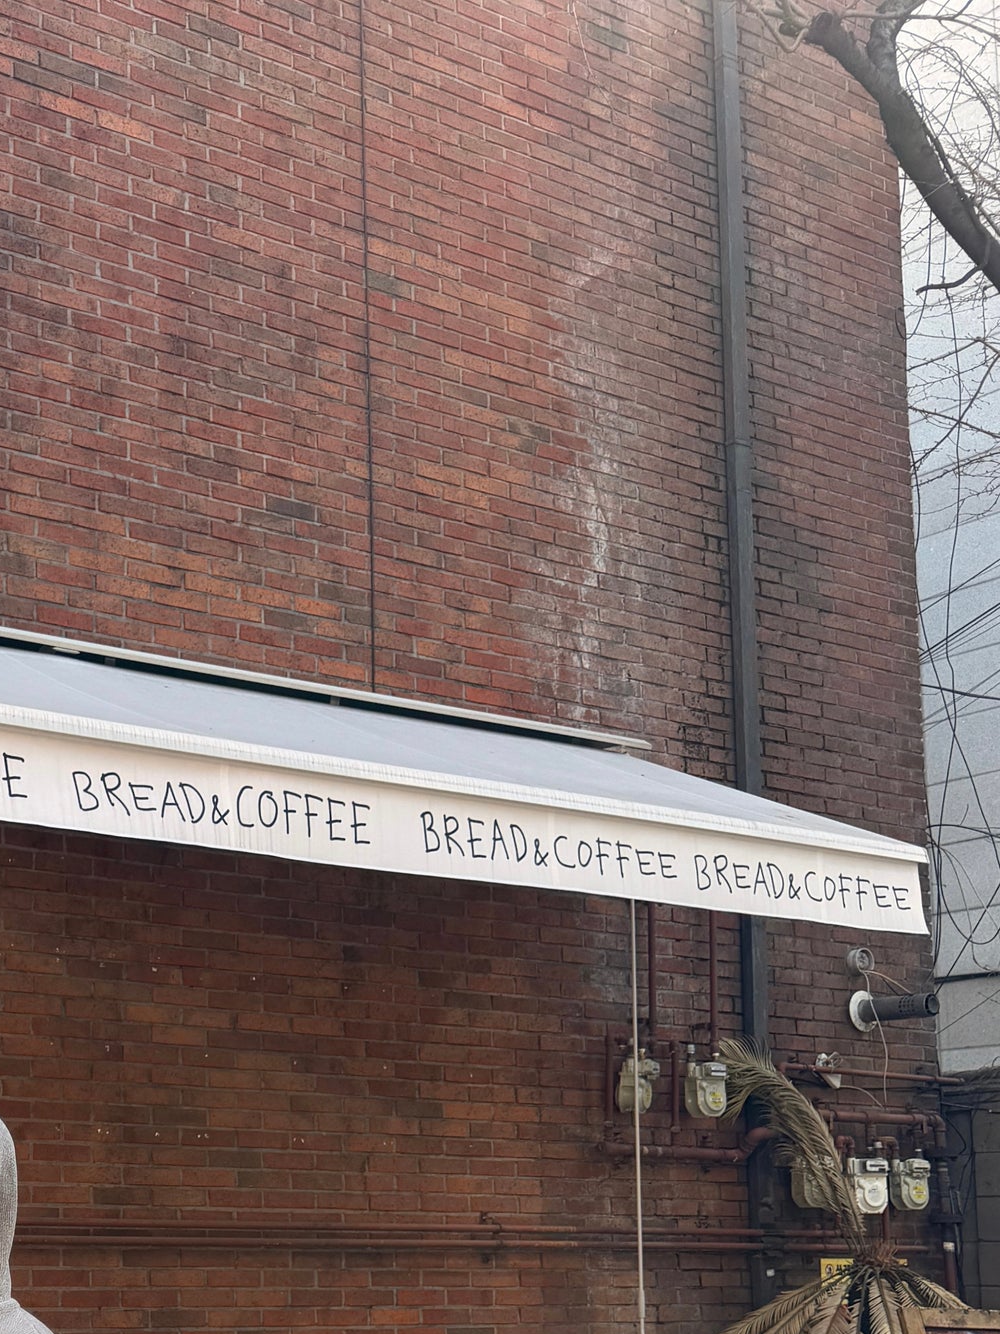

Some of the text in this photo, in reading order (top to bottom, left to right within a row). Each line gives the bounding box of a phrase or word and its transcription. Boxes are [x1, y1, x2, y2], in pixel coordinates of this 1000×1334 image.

[72, 771, 371, 845] BREAD&COFFEE
[420, 811, 677, 878] BREAD&COFFEE
[694, 854, 911, 910] BREAD&COFFEE
